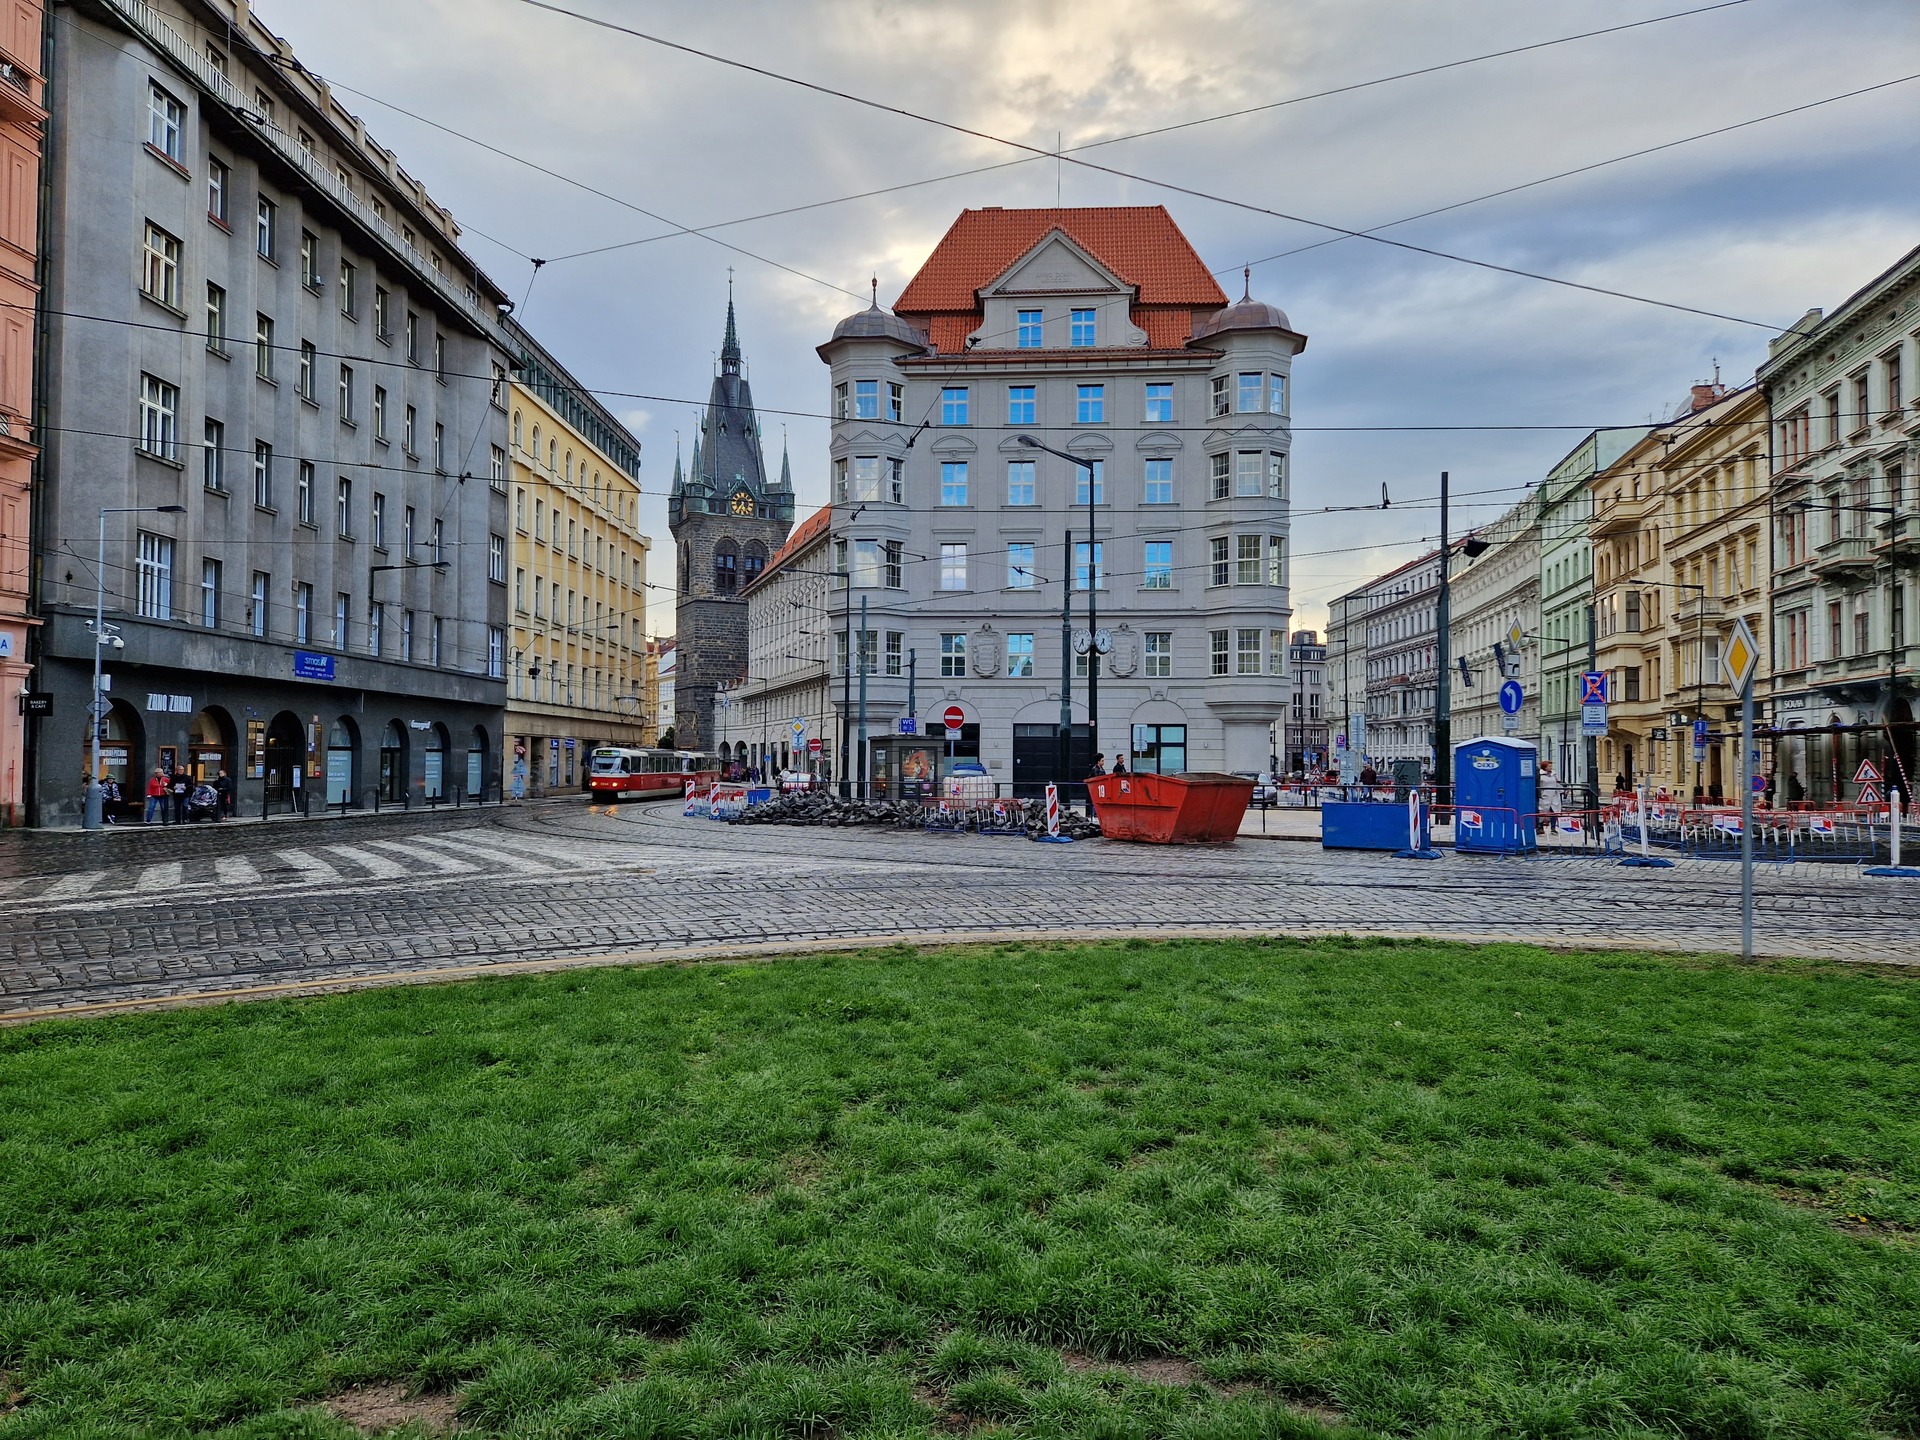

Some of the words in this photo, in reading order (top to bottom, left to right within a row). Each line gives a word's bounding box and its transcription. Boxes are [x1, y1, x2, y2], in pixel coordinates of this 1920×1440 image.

[147, 693, 167, 711] ZRNO
[168, 695, 192, 713] ZRNKO
[1098, 784, 1105, 798] 19
